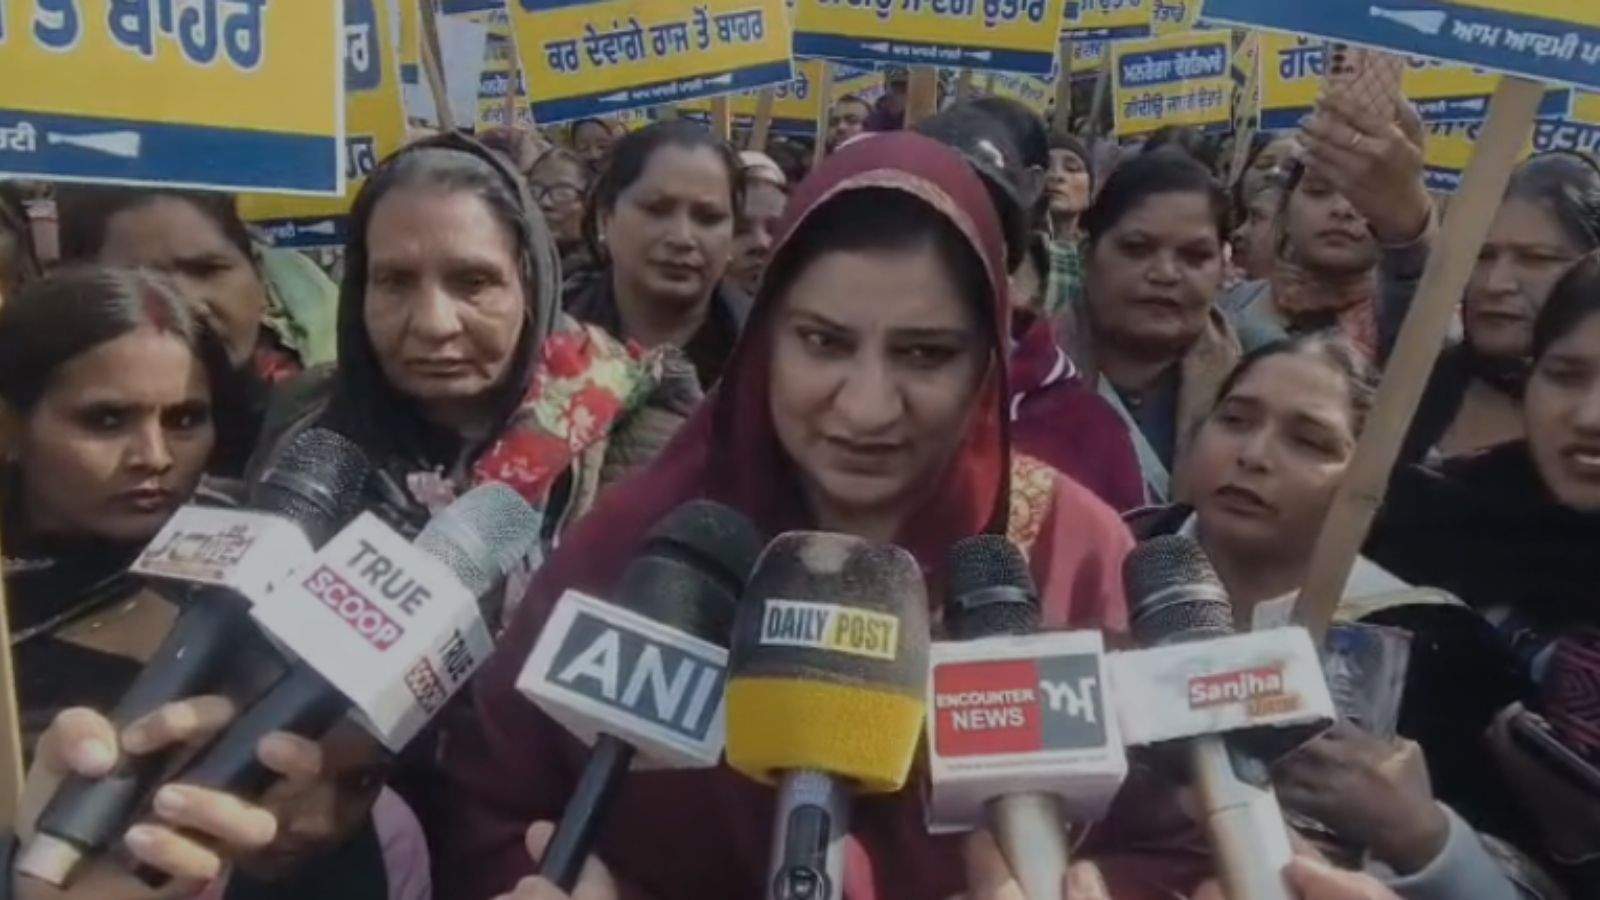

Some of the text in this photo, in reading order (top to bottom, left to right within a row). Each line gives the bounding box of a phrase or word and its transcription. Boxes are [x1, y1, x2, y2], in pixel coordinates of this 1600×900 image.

[544, 40, 579, 72] ਕਰ
[649, 22, 690, 56] ਰਾਜ
[713, 10, 764, 43] ਬਾਹਰ
[1452, 19, 1500, 47] ਆਮ
[1504, 29, 1579, 61] ਆਦਮੀ
[348, 539, 432, 615] TRUE
[306, 567, 403, 648] SCOOP
[767, 605, 890, 654] DAILY POST
[558, 629, 719, 732] ANI
[935, 687, 1035, 708] ENCOUNTER
[1190, 672, 1281, 704] Sanjha
[953, 706, 1025, 731] NEWS
